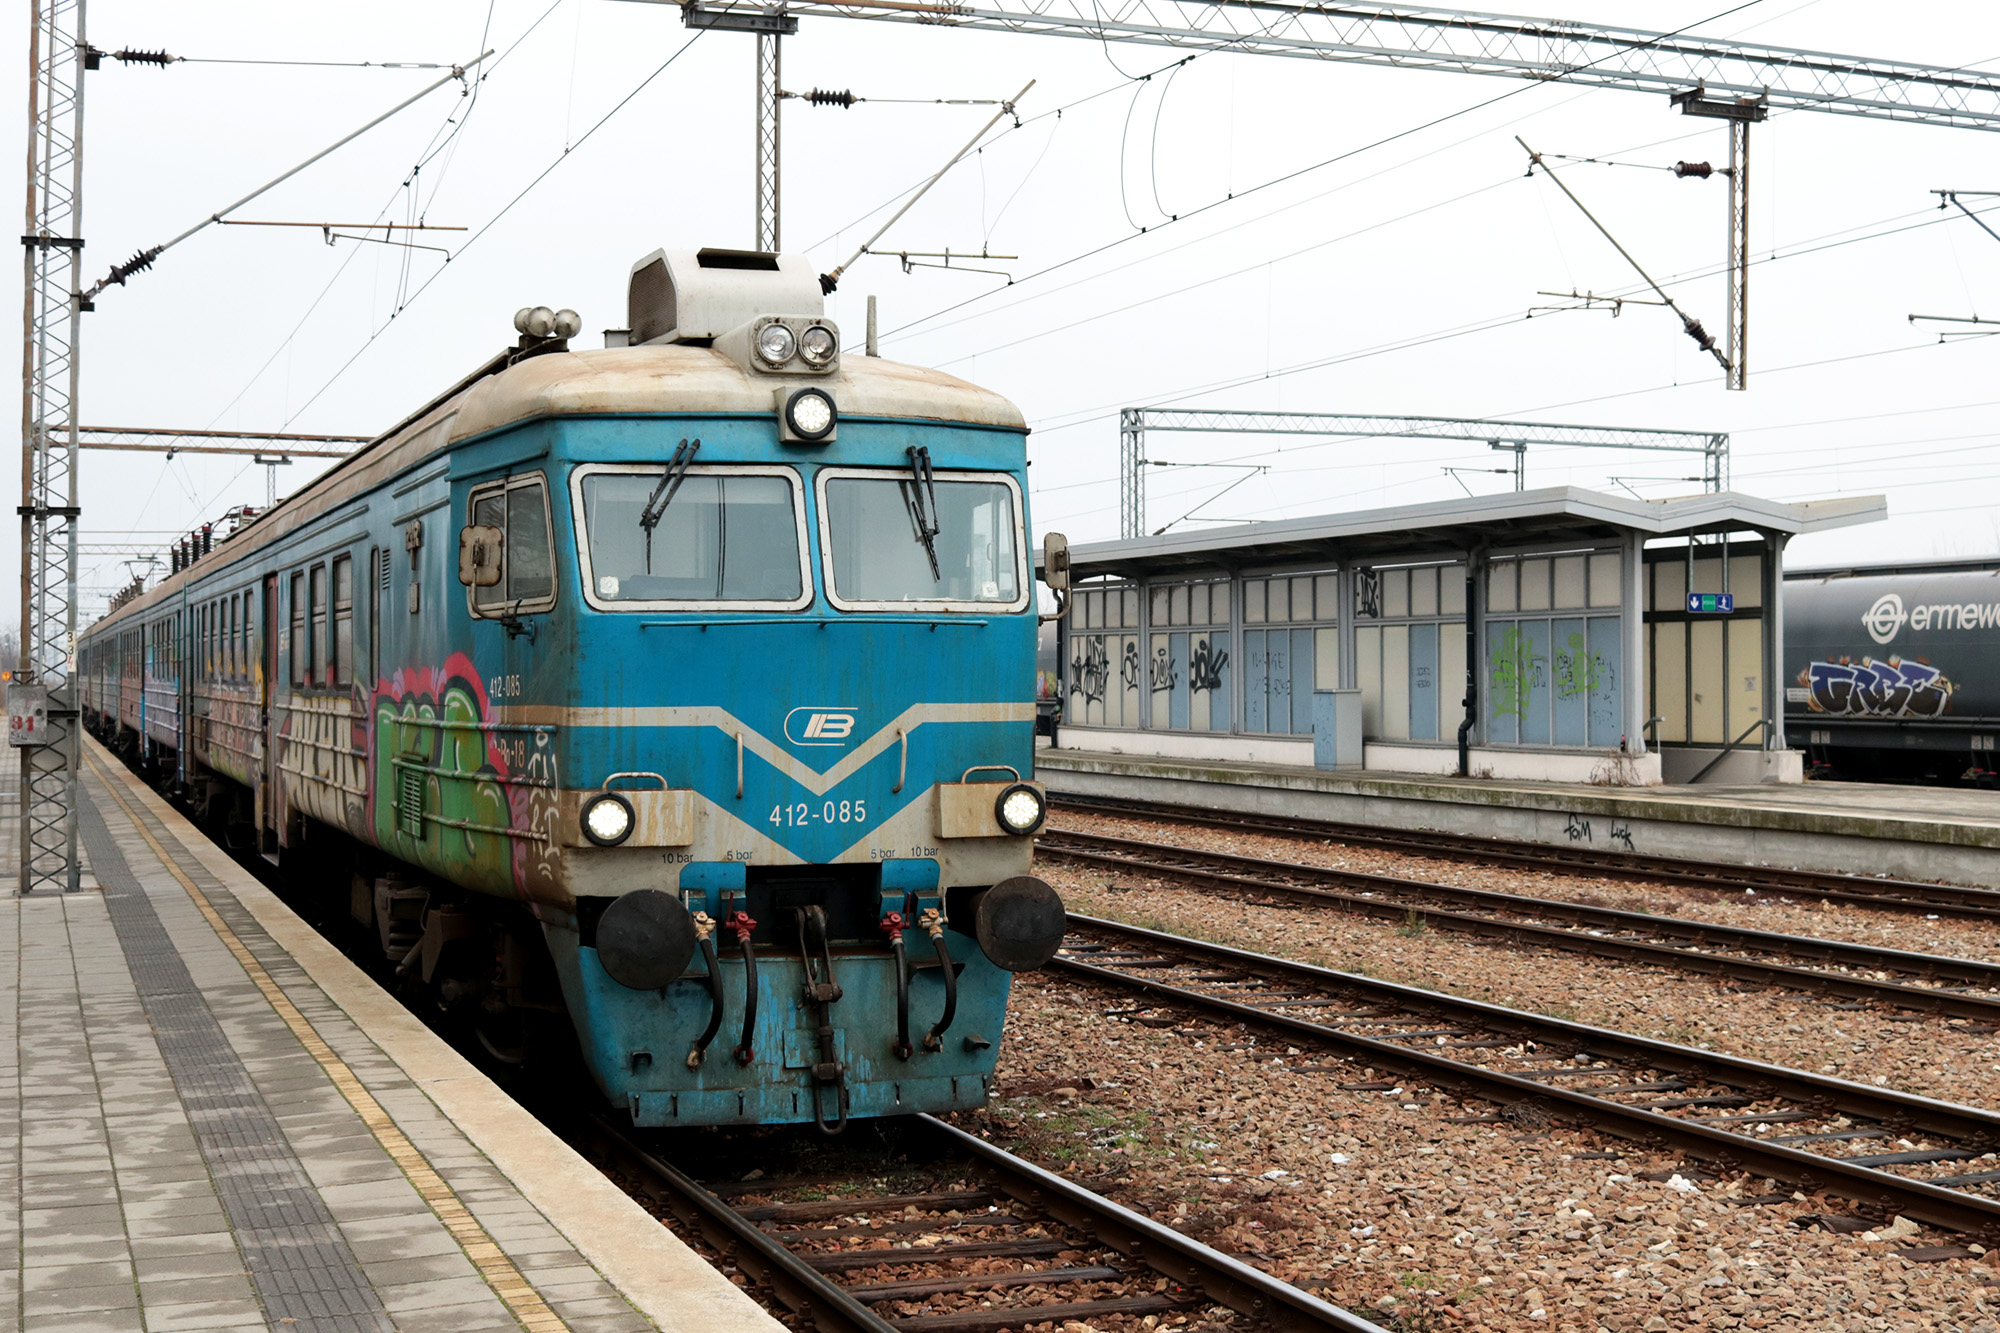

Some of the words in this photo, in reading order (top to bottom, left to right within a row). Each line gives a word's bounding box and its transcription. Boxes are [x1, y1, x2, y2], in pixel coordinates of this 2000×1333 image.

[1910, 603, 2000, 631] ermew
[489, 674, 521, 698] 412-085
[769, 799, 866, 827] 412-085
[726, 850, 733, 861] 5
[736, 849, 753, 860] bar
[871, 848, 877, 859] 5
[880, 848, 896, 858] bar
[911, 846, 922, 857] 10
[924, 845, 939, 857] bar
[662, 853, 674, 864] 10
[677, 852, 694, 863] bar
